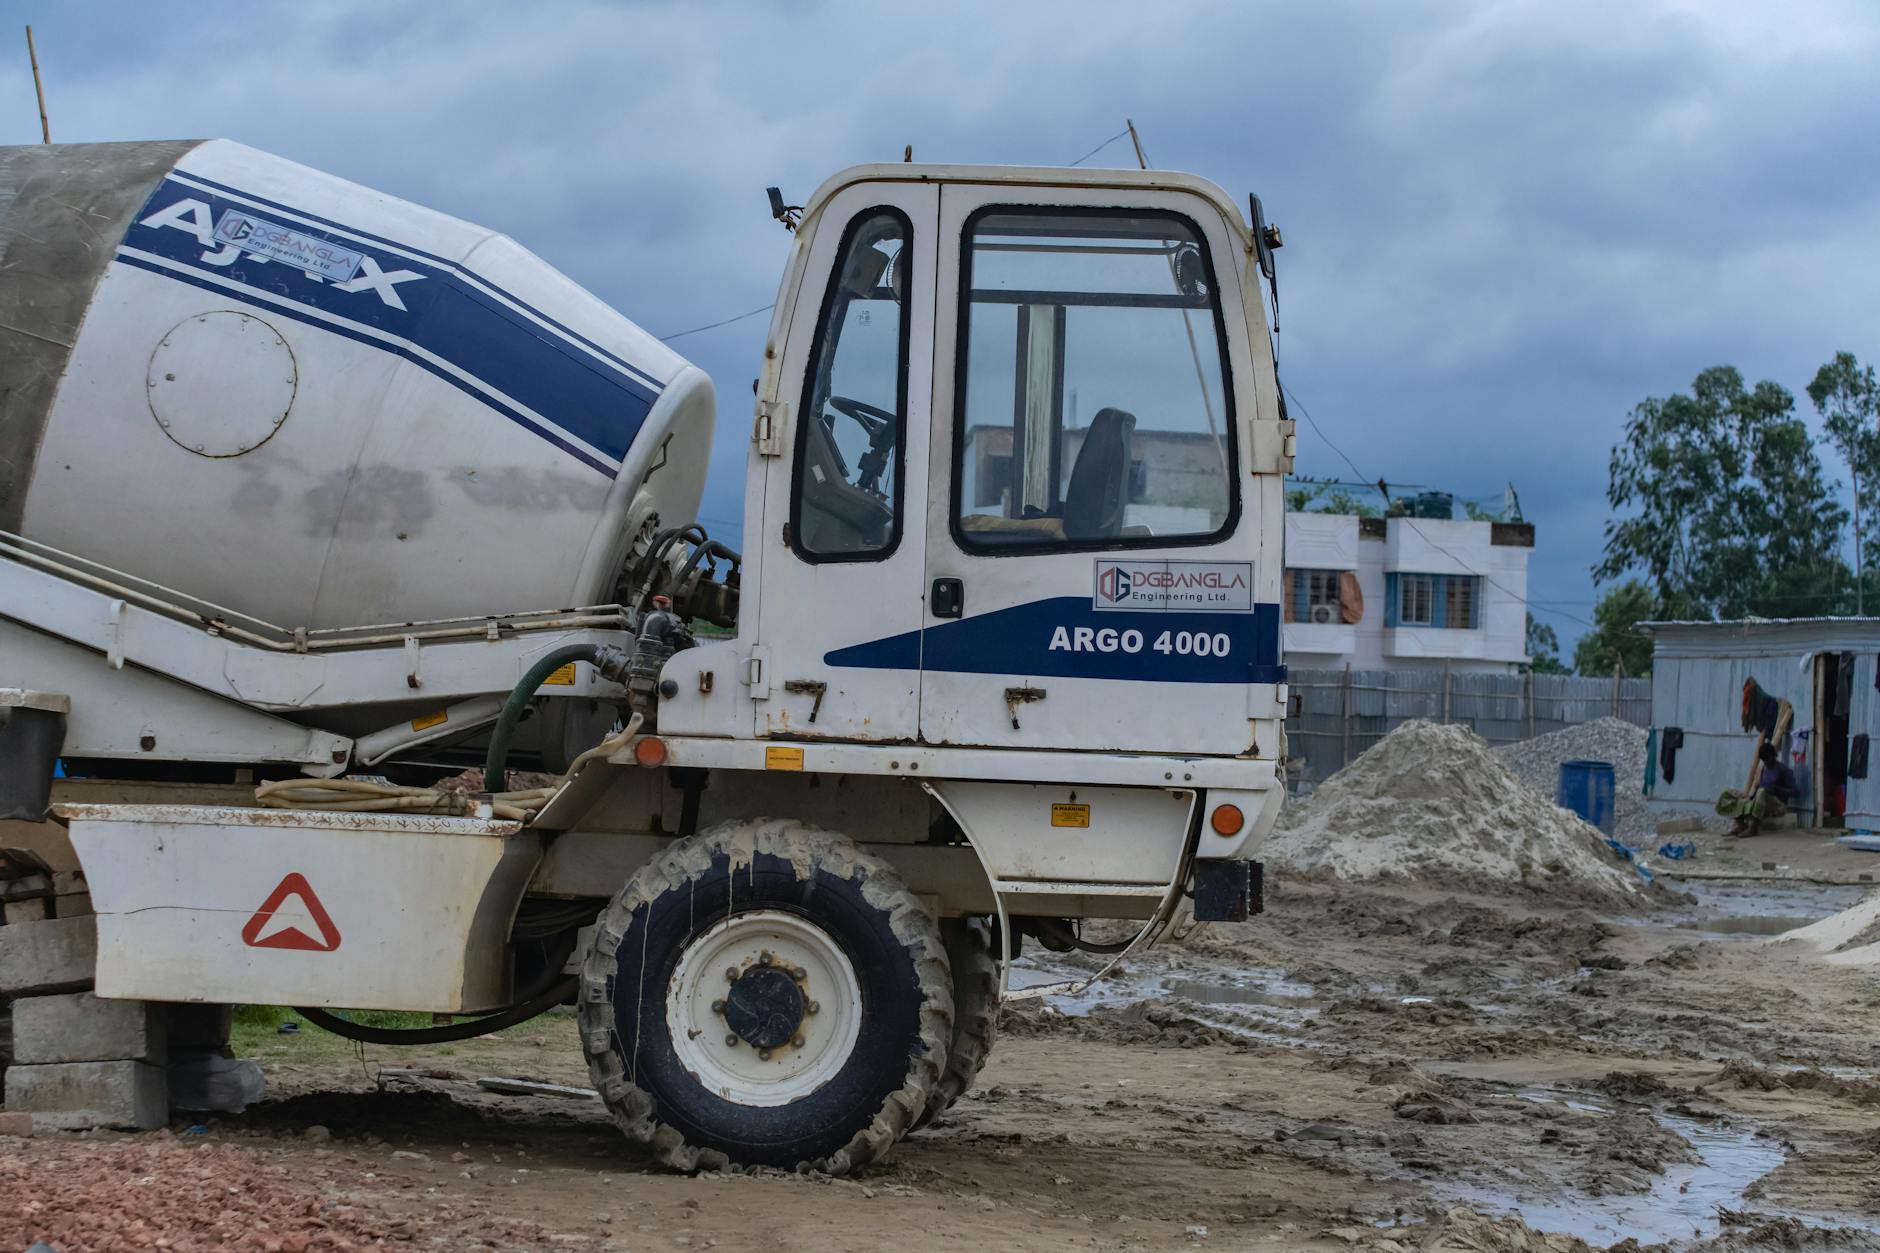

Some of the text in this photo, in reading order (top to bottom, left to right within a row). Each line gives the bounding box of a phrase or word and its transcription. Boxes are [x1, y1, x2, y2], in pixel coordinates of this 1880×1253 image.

[247, 238, 311, 265] Engineering
[252, 227, 354, 268] DGBANGLA
[1132, 571, 1246, 589] DGBANGLA
[1132, 591, 1230, 603] Engineering Ltd.
[1049, 626, 1231, 658] ARGO 4000
